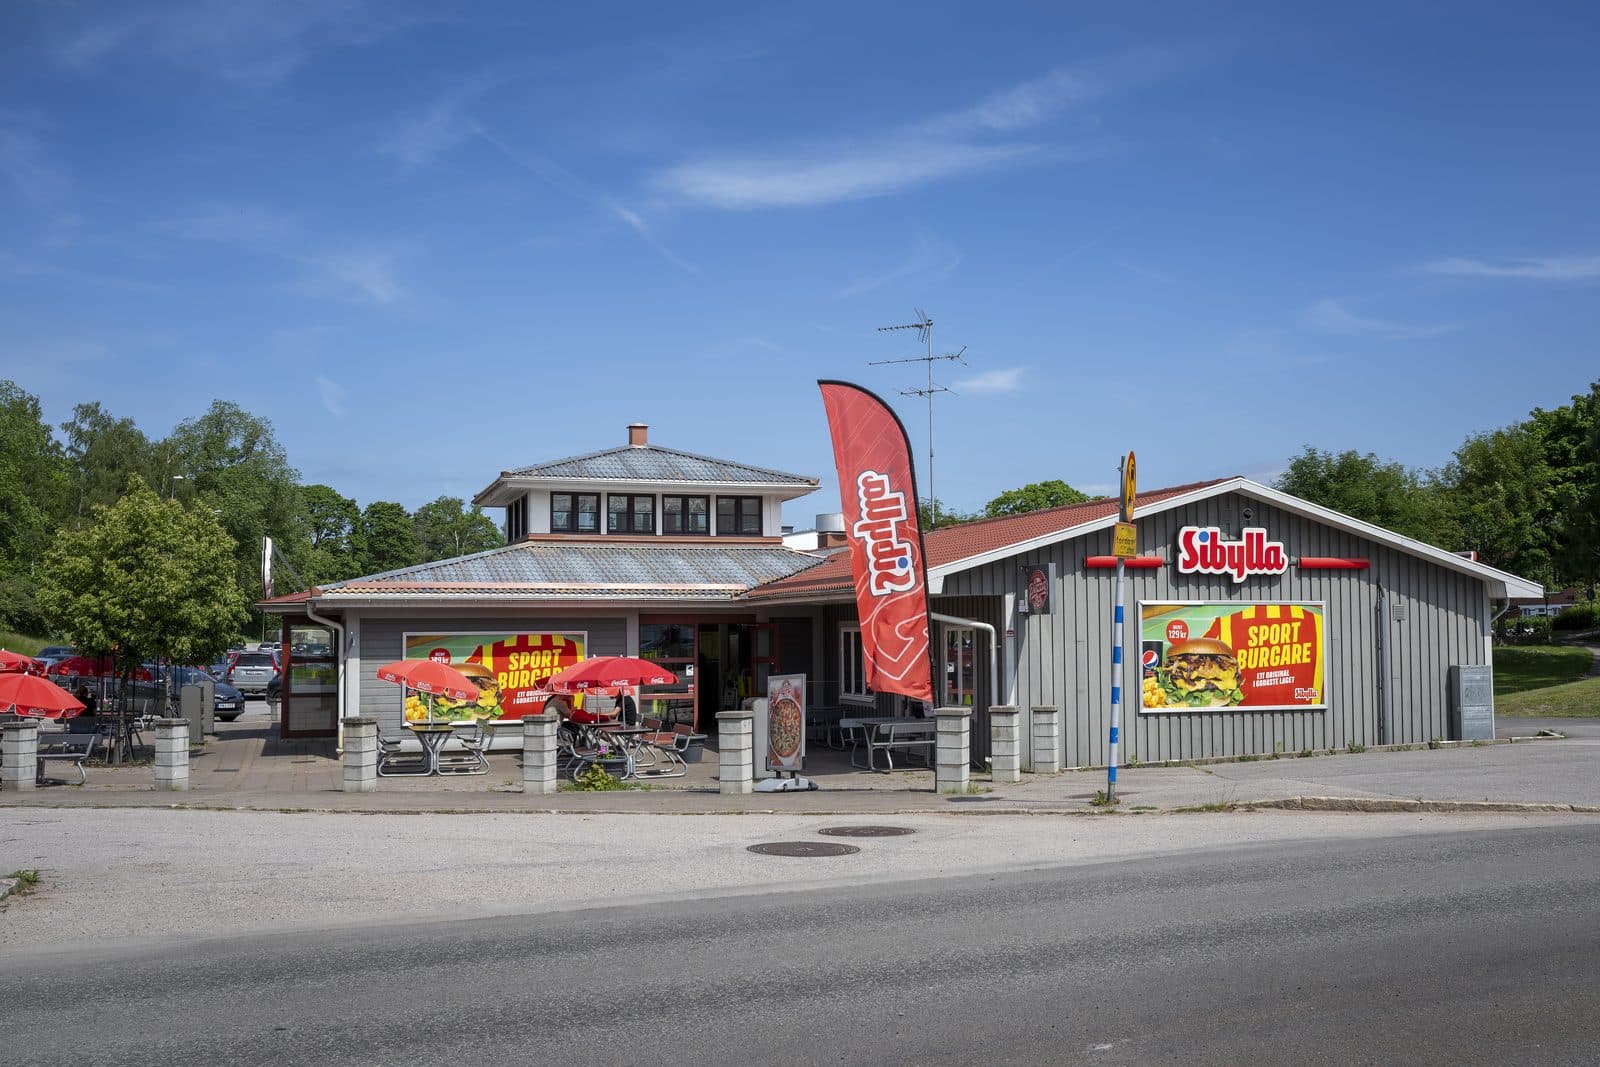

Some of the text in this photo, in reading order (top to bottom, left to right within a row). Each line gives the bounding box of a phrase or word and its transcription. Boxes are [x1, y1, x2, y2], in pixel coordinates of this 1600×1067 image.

[857, 475, 911, 590] Sibylla
[1180, 529, 1287, 581] Sibylla
[1168, 629, 1180, 639] 129
[1247, 621, 1302, 647] SPORT
[508, 648, 562, 671] SPORT
[1237, 642, 1312, 670] BURGARE
